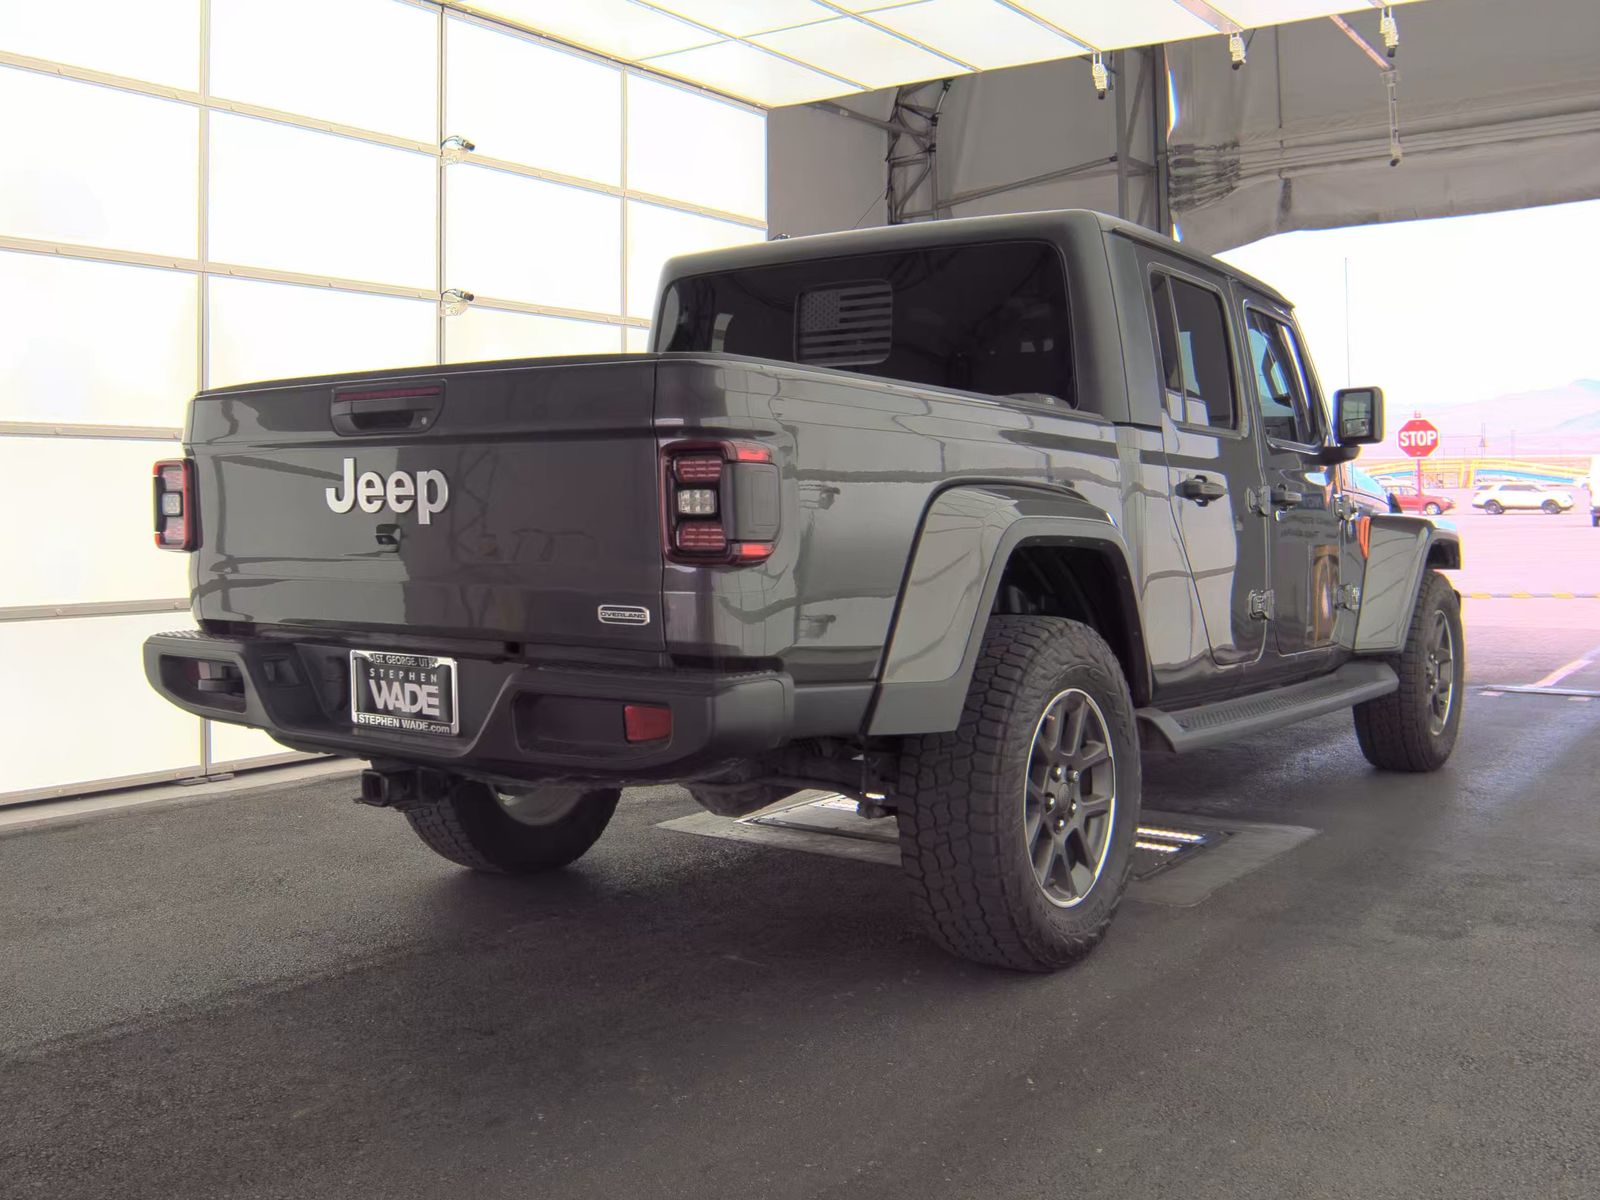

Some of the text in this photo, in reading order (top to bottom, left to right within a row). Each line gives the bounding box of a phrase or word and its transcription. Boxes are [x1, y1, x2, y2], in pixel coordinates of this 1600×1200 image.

[1400, 431, 1437, 447] STOP
[325, 458, 449, 525] Jeep
[600, 611, 646, 619] OVERLAND
[369, 668, 438, 683] STEPHEN
[369, 679, 440, 717] WADE
[358, 714, 450, 734] STEPHEN WADE.com
